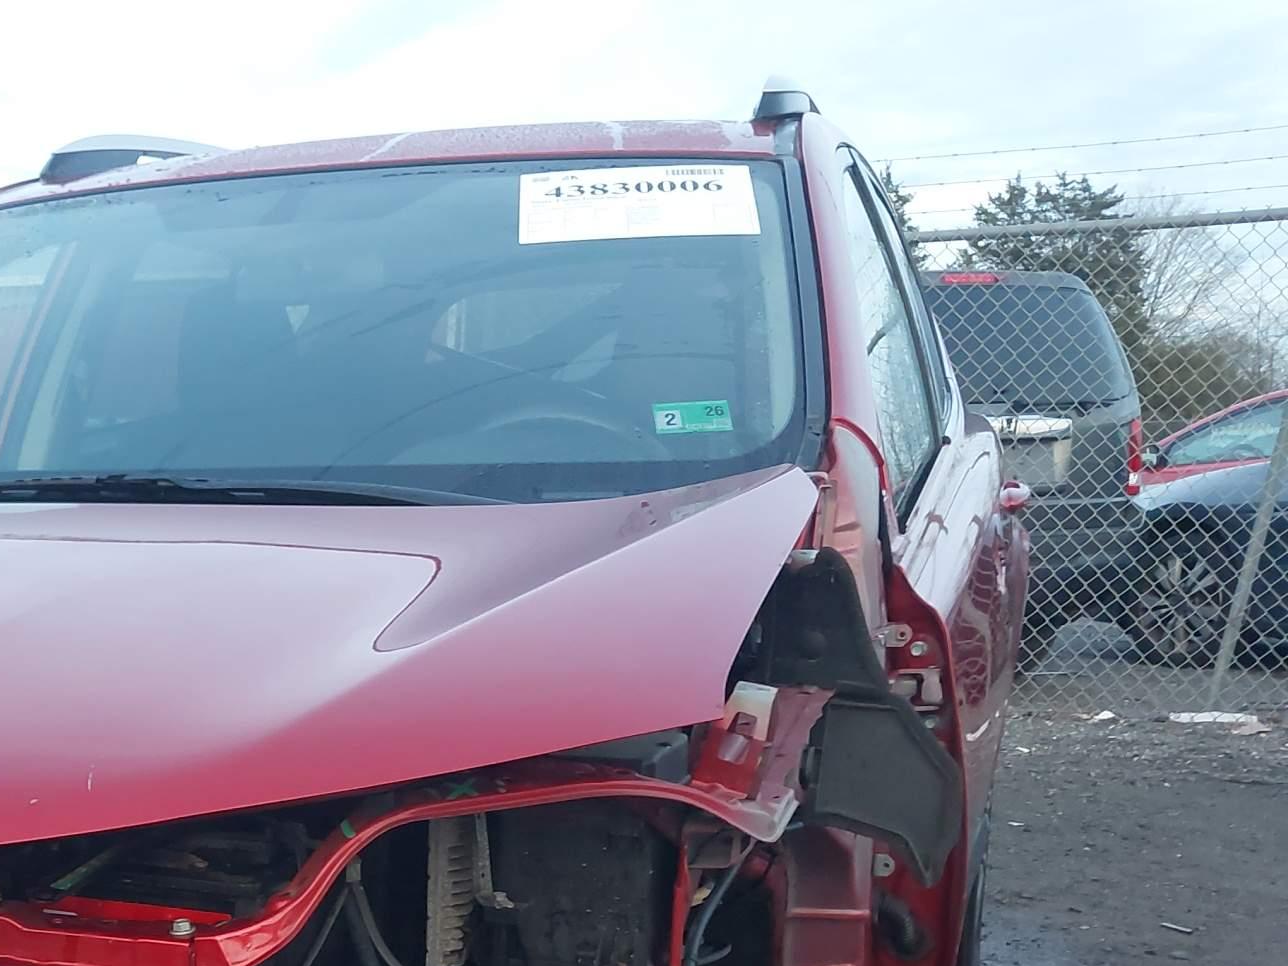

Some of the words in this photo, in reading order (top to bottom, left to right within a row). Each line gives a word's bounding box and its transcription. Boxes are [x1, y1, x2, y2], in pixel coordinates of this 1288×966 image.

[544, 178, 723, 198] 43830006
[705, 405, 724, 417] 26
[664, 412, 677, 426] 2
